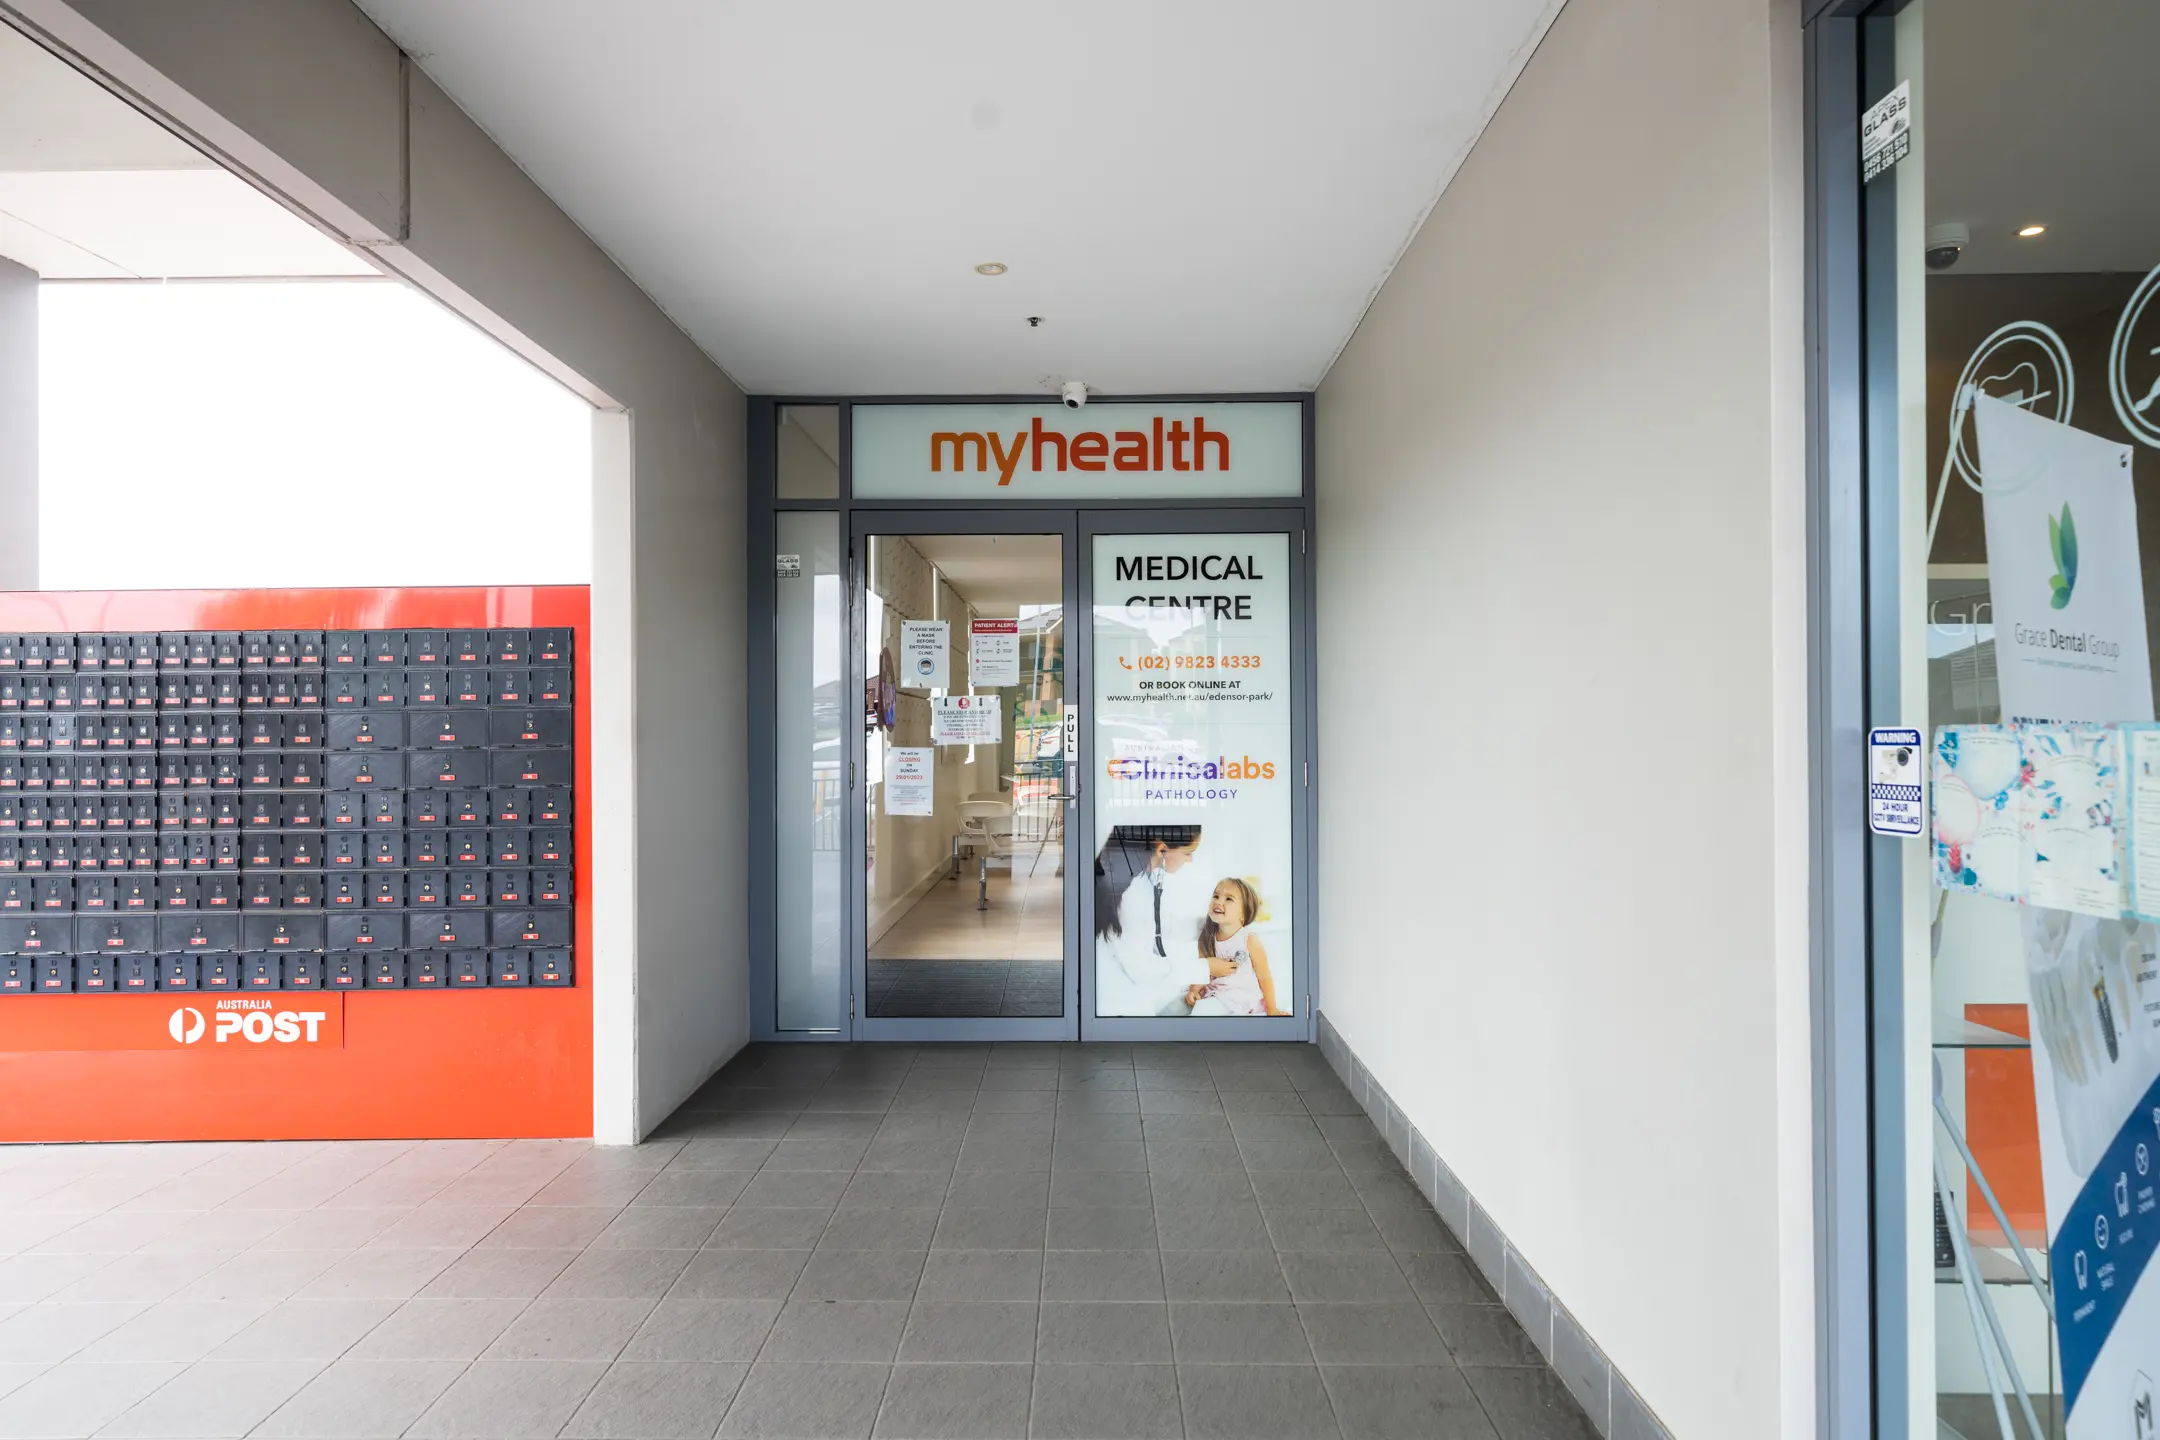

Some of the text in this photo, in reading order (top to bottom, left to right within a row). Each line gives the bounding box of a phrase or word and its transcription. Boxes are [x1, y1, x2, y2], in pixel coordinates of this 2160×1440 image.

[1864, 96, 1906, 138] GLASS
[931, 416, 1230, 486] myhealth
[1116, 555, 1263, 581] MEDICAL
[1125, 595, 1252, 620] CENTRE
[2014, 623, 2120, 662] Grace Dental Group
[1138, 656, 1261, 671] (02) 9823 4333
[1139, 681, 1154, 689] OR
[1107, 692, 1273, 703] www.myhealth.net.au/edensor-park/
[1874, 732, 1916, 743] WARNING
[1146, 789, 1238, 799] PATHOLOGY
[1882, 802, 1908, 812] 24 HOUR
[216, 1000, 272, 1010] AUSTRALIA
[216, 1011, 326, 1043] POST
